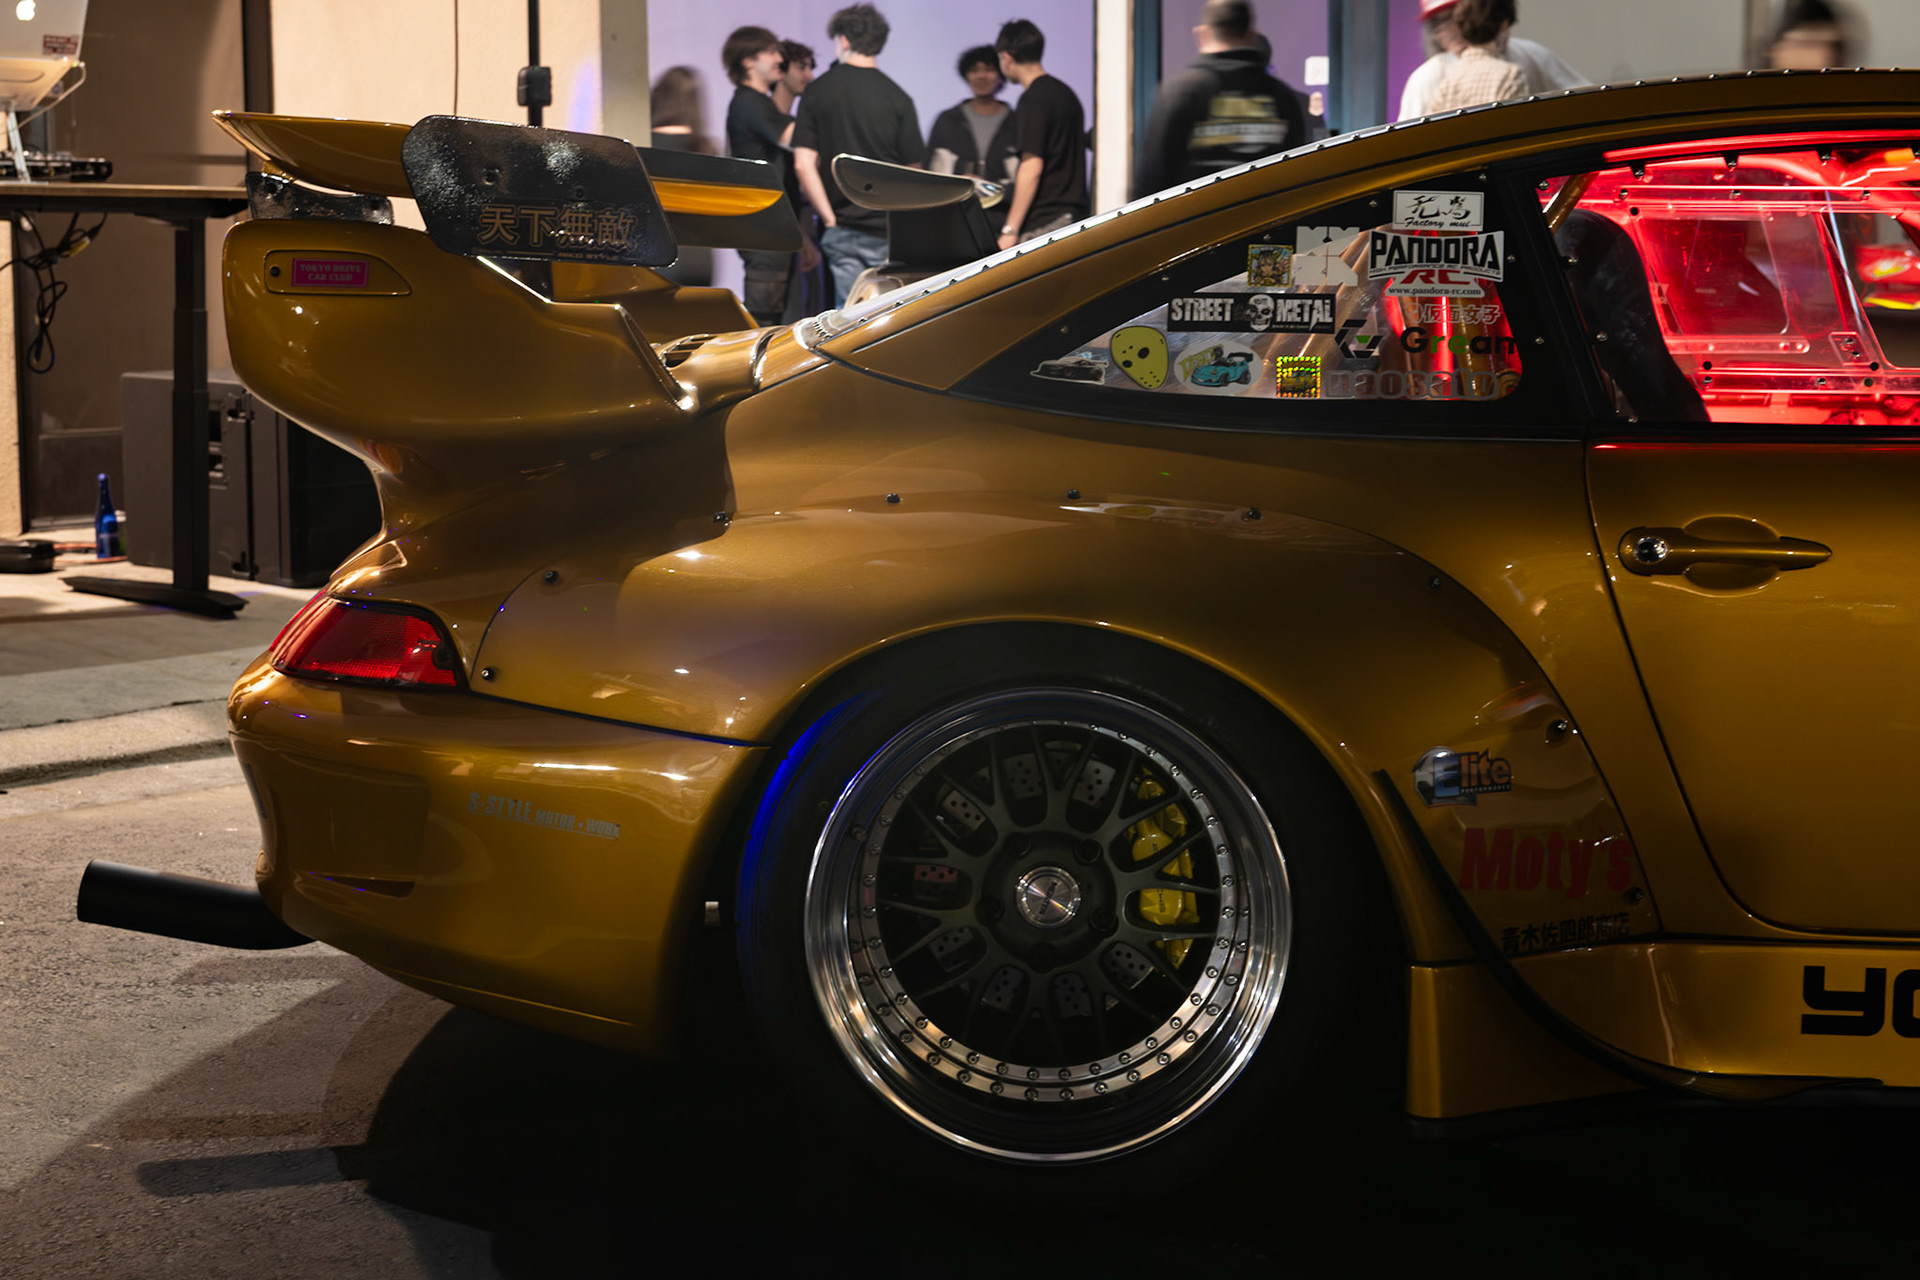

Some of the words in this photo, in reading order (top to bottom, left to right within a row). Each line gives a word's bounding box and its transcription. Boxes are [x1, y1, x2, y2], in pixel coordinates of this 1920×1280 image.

[1404, 217, 1444, 228] Factory
[1371, 231, 1500, 271] PANDORA
[299, 263, 331, 272] TOKYO
[333, 264, 362, 273] DRIVE
[1460, 265, 1501, 275] PRODUCTS
[308, 273, 327, 281] CAR
[329, 273, 353, 282] CLUB
[1400, 269, 1471, 285] RC
[1388, 286, 1481, 296] www.pandora-rc.com
[1171, 297, 1234, 322] STREET
[1277, 298, 1334, 331] METAL
[1434, 754, 1510, 798] Elite
[468, 792, 533, 823] S-STYLE
[1459, 827, 1634, 899] Moty's
